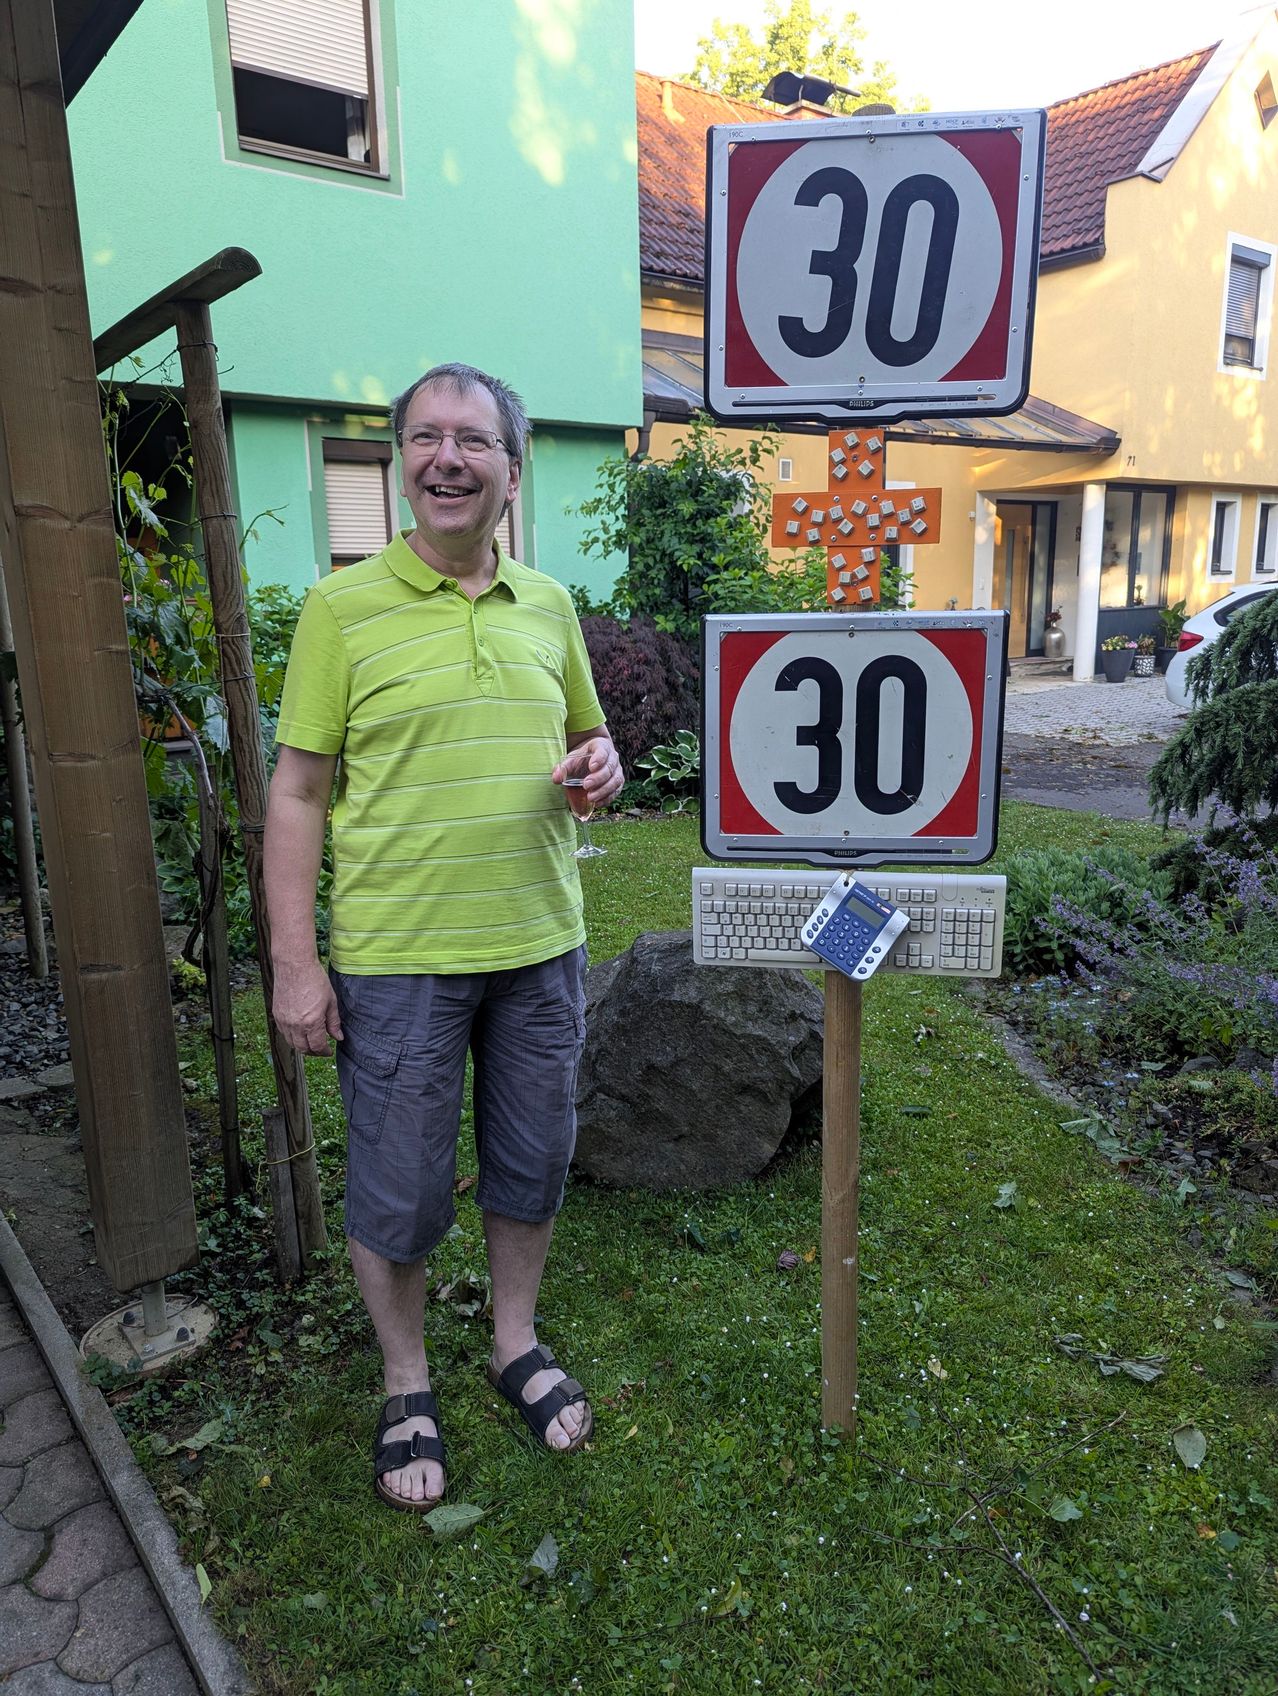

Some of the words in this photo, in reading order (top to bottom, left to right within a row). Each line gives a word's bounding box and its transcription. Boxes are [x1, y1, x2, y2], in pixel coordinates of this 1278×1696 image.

[778, 166, 960, 367] 30
[1126, 455, 1136, 467] 71
[774, 655, 928, 815] 30
